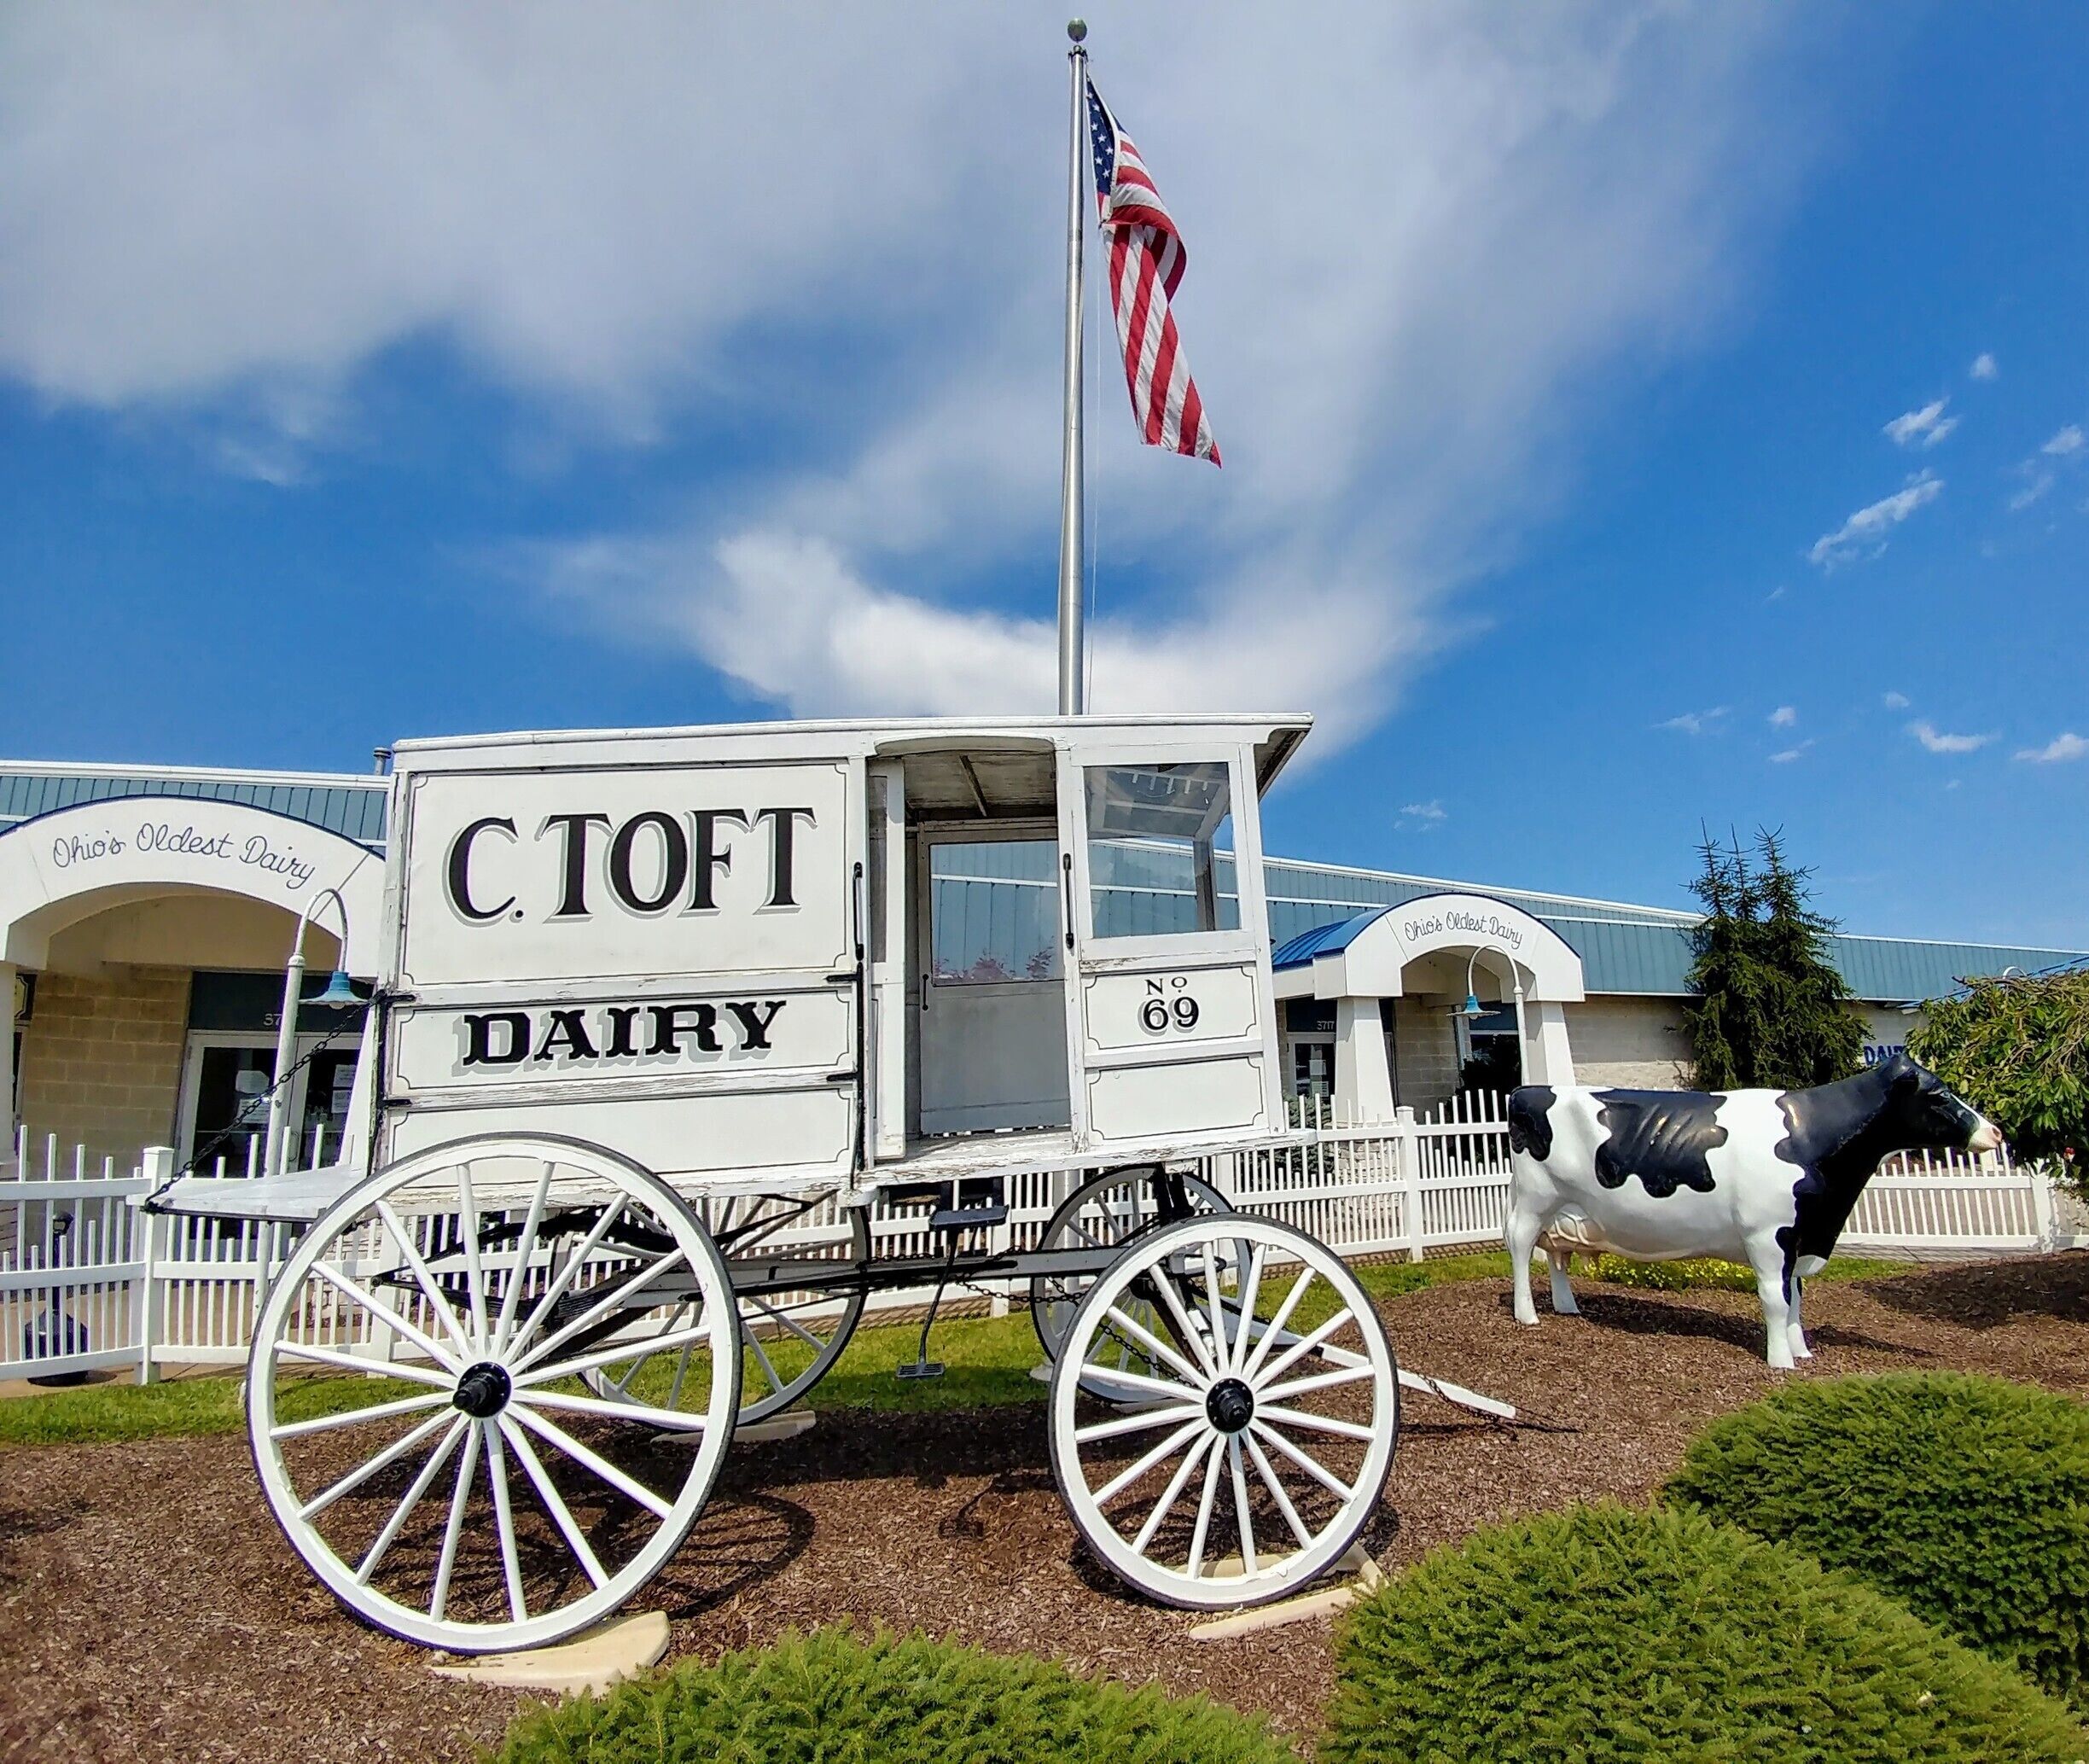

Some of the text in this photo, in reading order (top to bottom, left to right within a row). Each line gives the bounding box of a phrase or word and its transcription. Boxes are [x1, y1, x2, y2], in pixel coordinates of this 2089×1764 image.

[53, 823, 316, 889] Ohio's Oldest Dairy
[447, 806, 818, 920] C. TOFT
[1404, 911, 1523, 950] Ohio's Oldest Dairy
[459, 1000, 787, 1068] DAIRY
[1141, 996, 1200, 1031] 69
[1316, 1021, 1335, 1031] 3717
